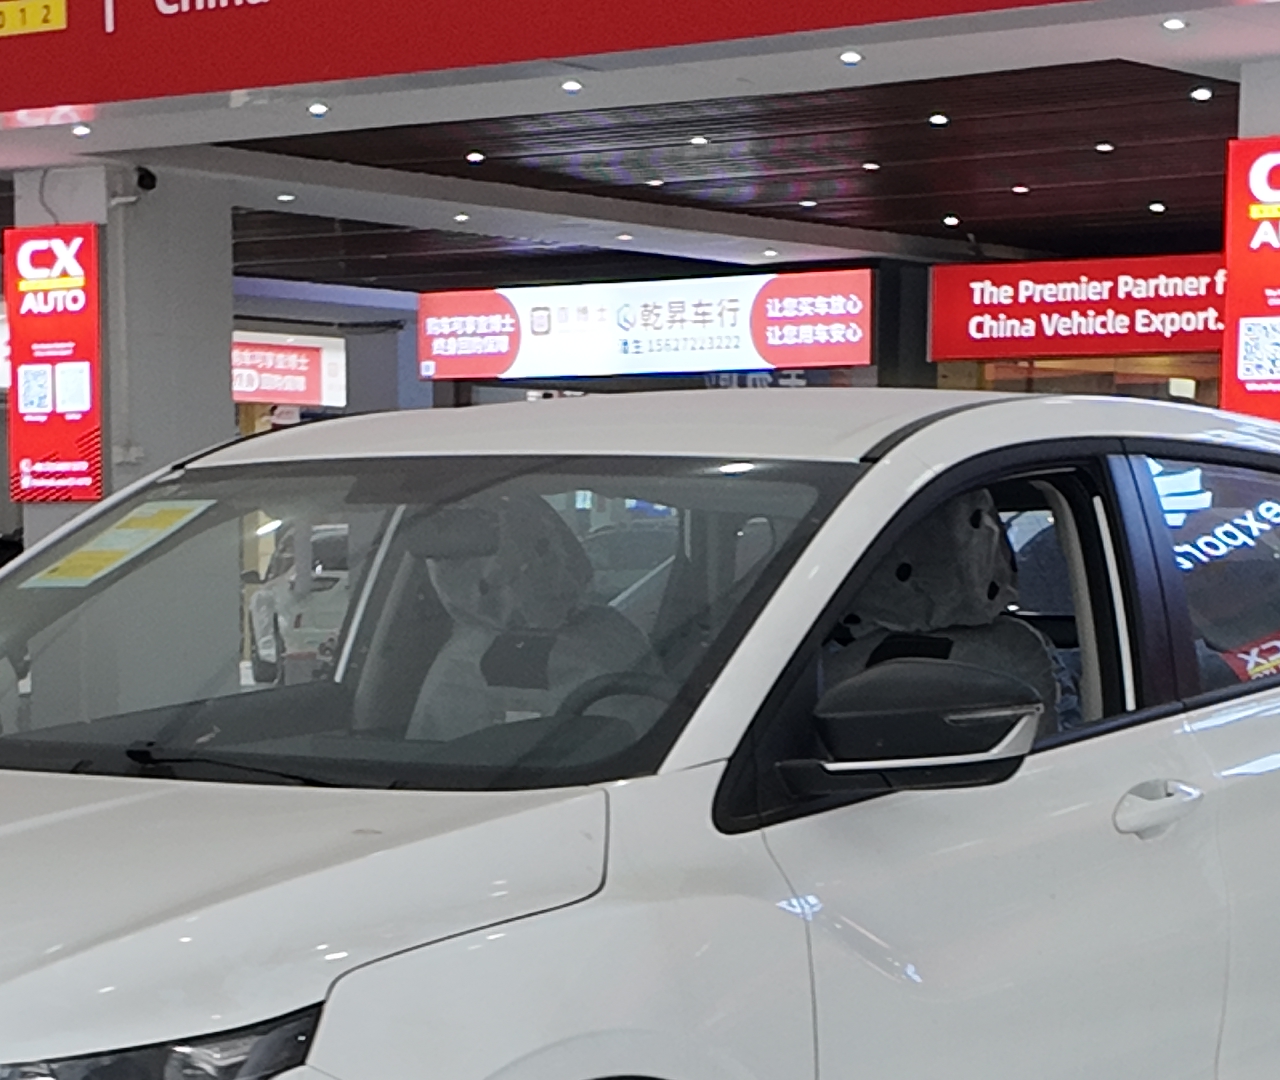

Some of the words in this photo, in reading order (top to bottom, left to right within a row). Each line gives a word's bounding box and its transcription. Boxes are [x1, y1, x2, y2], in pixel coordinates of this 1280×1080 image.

[16, 237, 85, 280] CX
[20, 290, 86, 314] AUTO
[969, 280, 1015, 305] The
[1017, 276, 1114, 303] Premier
[1117, 273, 1212, 299] Partner
[968, 313, 1036, 339] China
[1040, 308, 1131, 336] Vehicle
[1135, 306, 1225, 338] Export.
